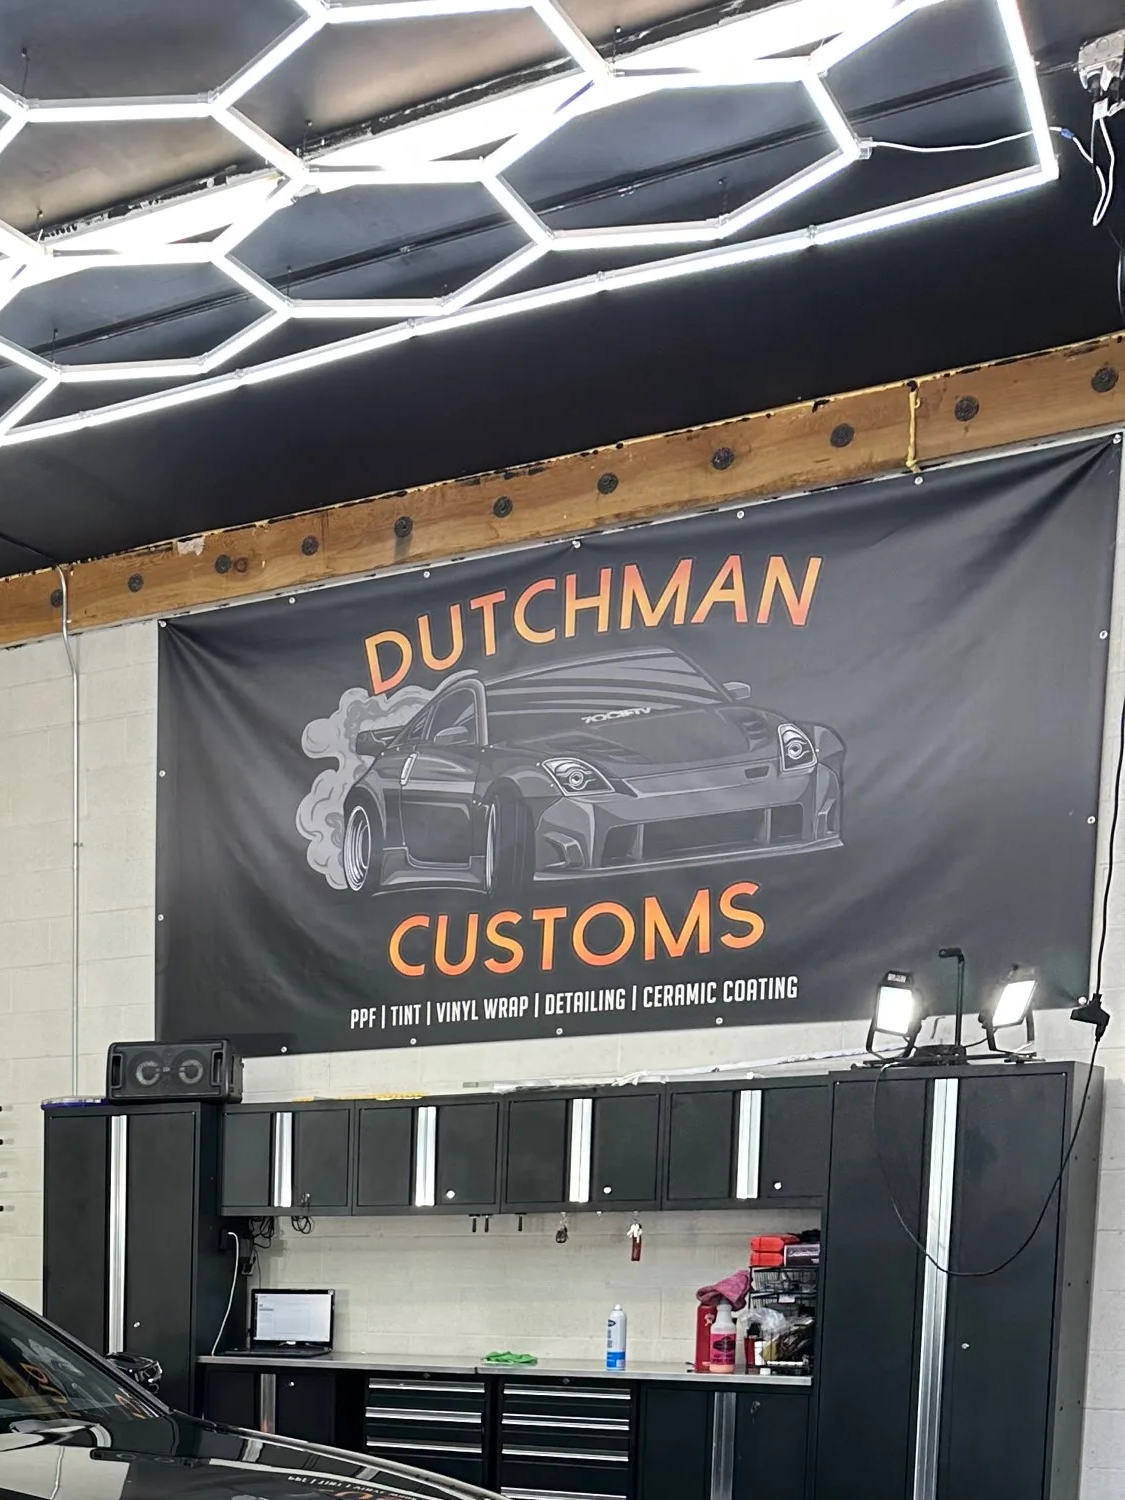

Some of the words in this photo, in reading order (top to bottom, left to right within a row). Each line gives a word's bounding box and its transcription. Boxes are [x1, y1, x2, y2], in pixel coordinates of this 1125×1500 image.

[364, 554, 824, 695] DUTCHMAN
[389, 881, 765, 977] CUSTOMS
[350, 1007, 376, 1029] PPF
[390, 1004, 421, 1027] TINT
[436, 999, 479, 1023] VINYL
[483, 995, 529, 1020] WRAP
[545, 988, 626, 1015] DETAILING
[643, 981, 717, 1008] CERAMIC
[723, 975, 798, 1003] COATING
